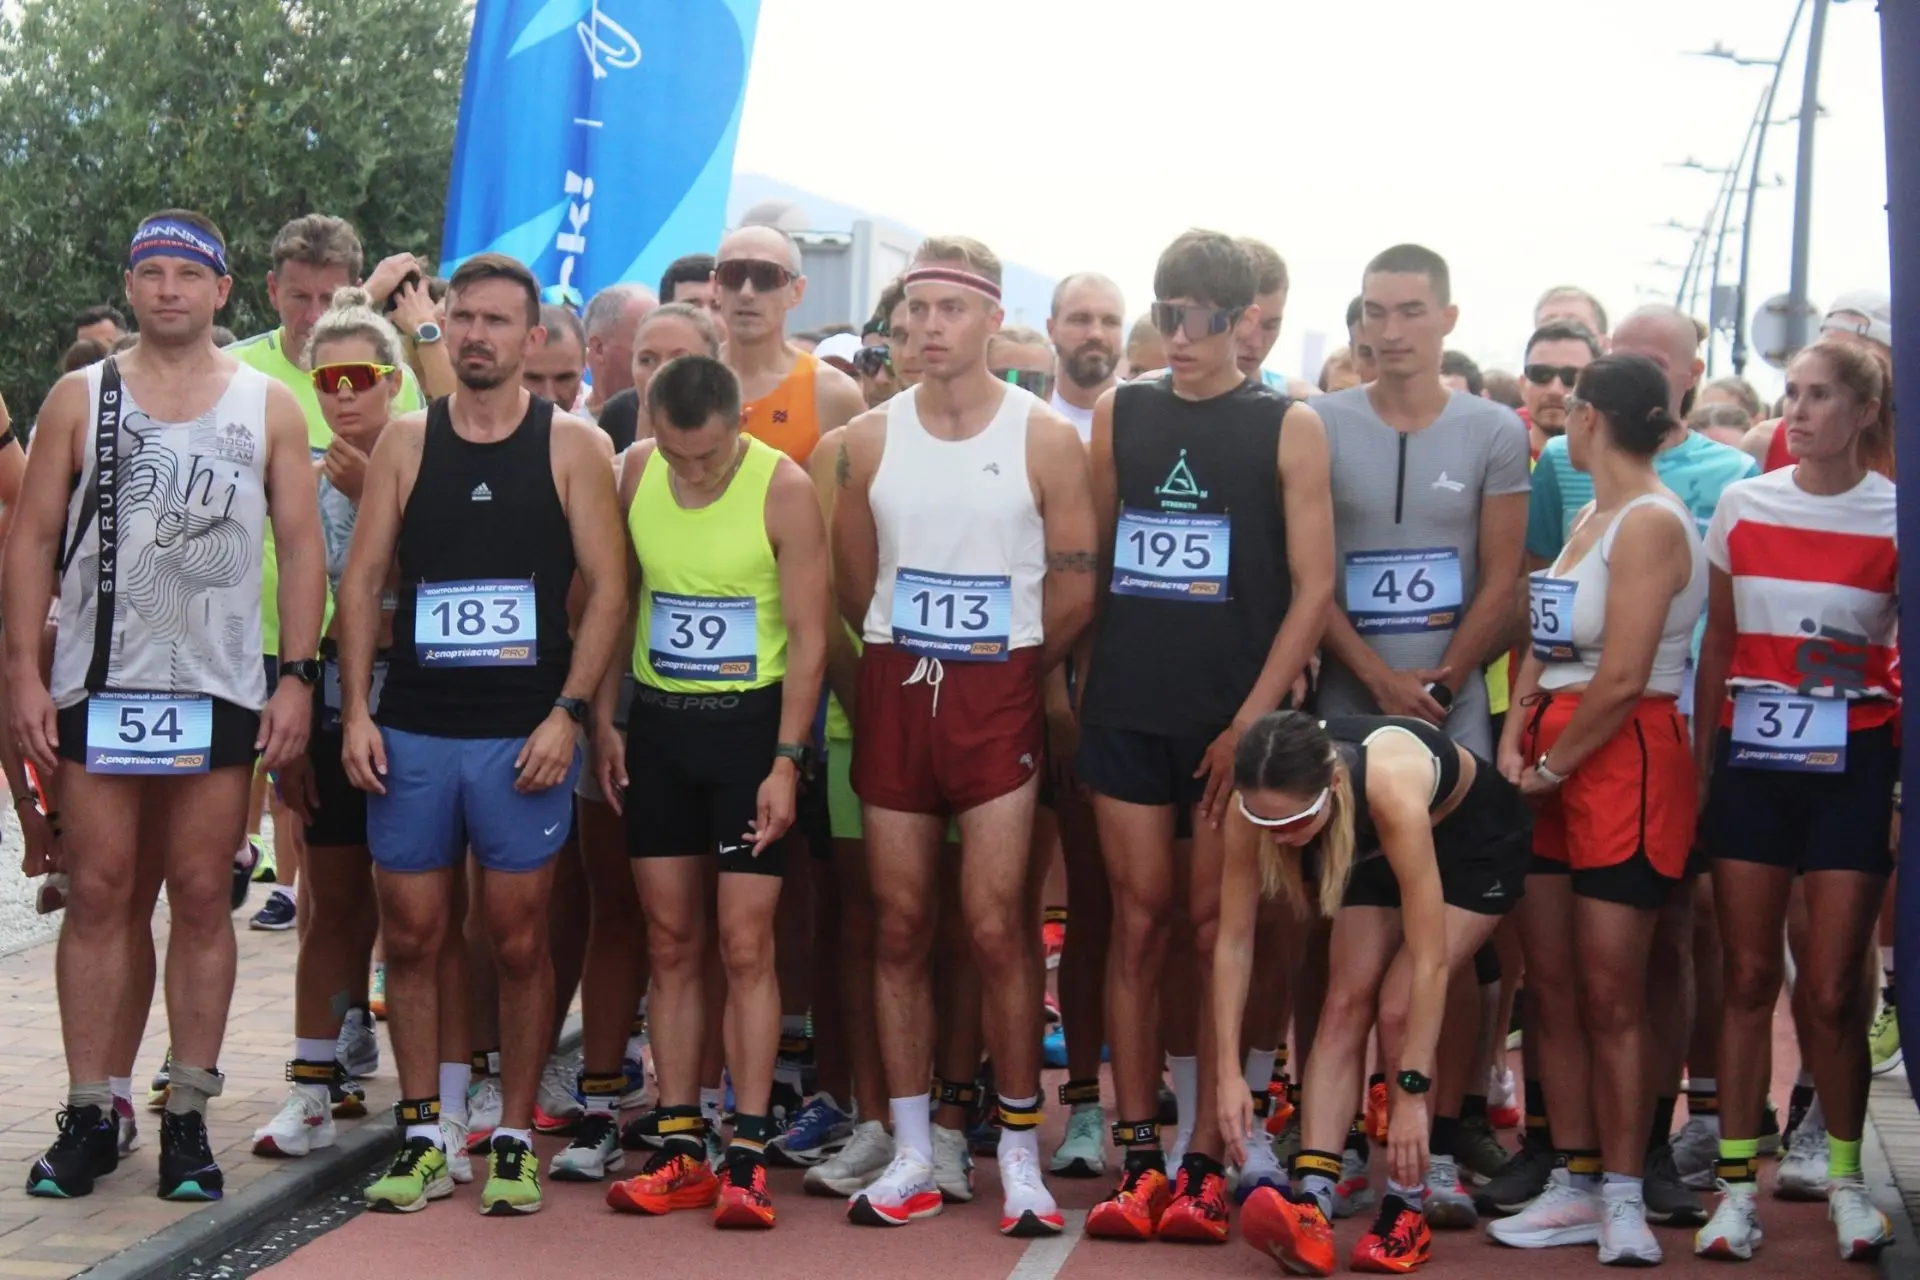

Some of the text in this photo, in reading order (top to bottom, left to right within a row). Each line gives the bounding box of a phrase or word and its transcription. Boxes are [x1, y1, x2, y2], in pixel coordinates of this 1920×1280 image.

[99, 390, 118, 593] SKYRUNNING
[1130, 530, 1211, 569] 195
[1372, 568, 1435, 604] 46
[432, 599, 520, 636] 183
[912, 591, 990, 630] 113
[669, 613, 728, 650] 39
[502, 648, 527, 657] PRO
[721, 663, 748, 673] PRO
[683, 695, 740, 711] PRO
[1757, 702, 1815, 739] 37
[118, 707, 183, 743] 54
[175, 755, 202, 766] PRO
